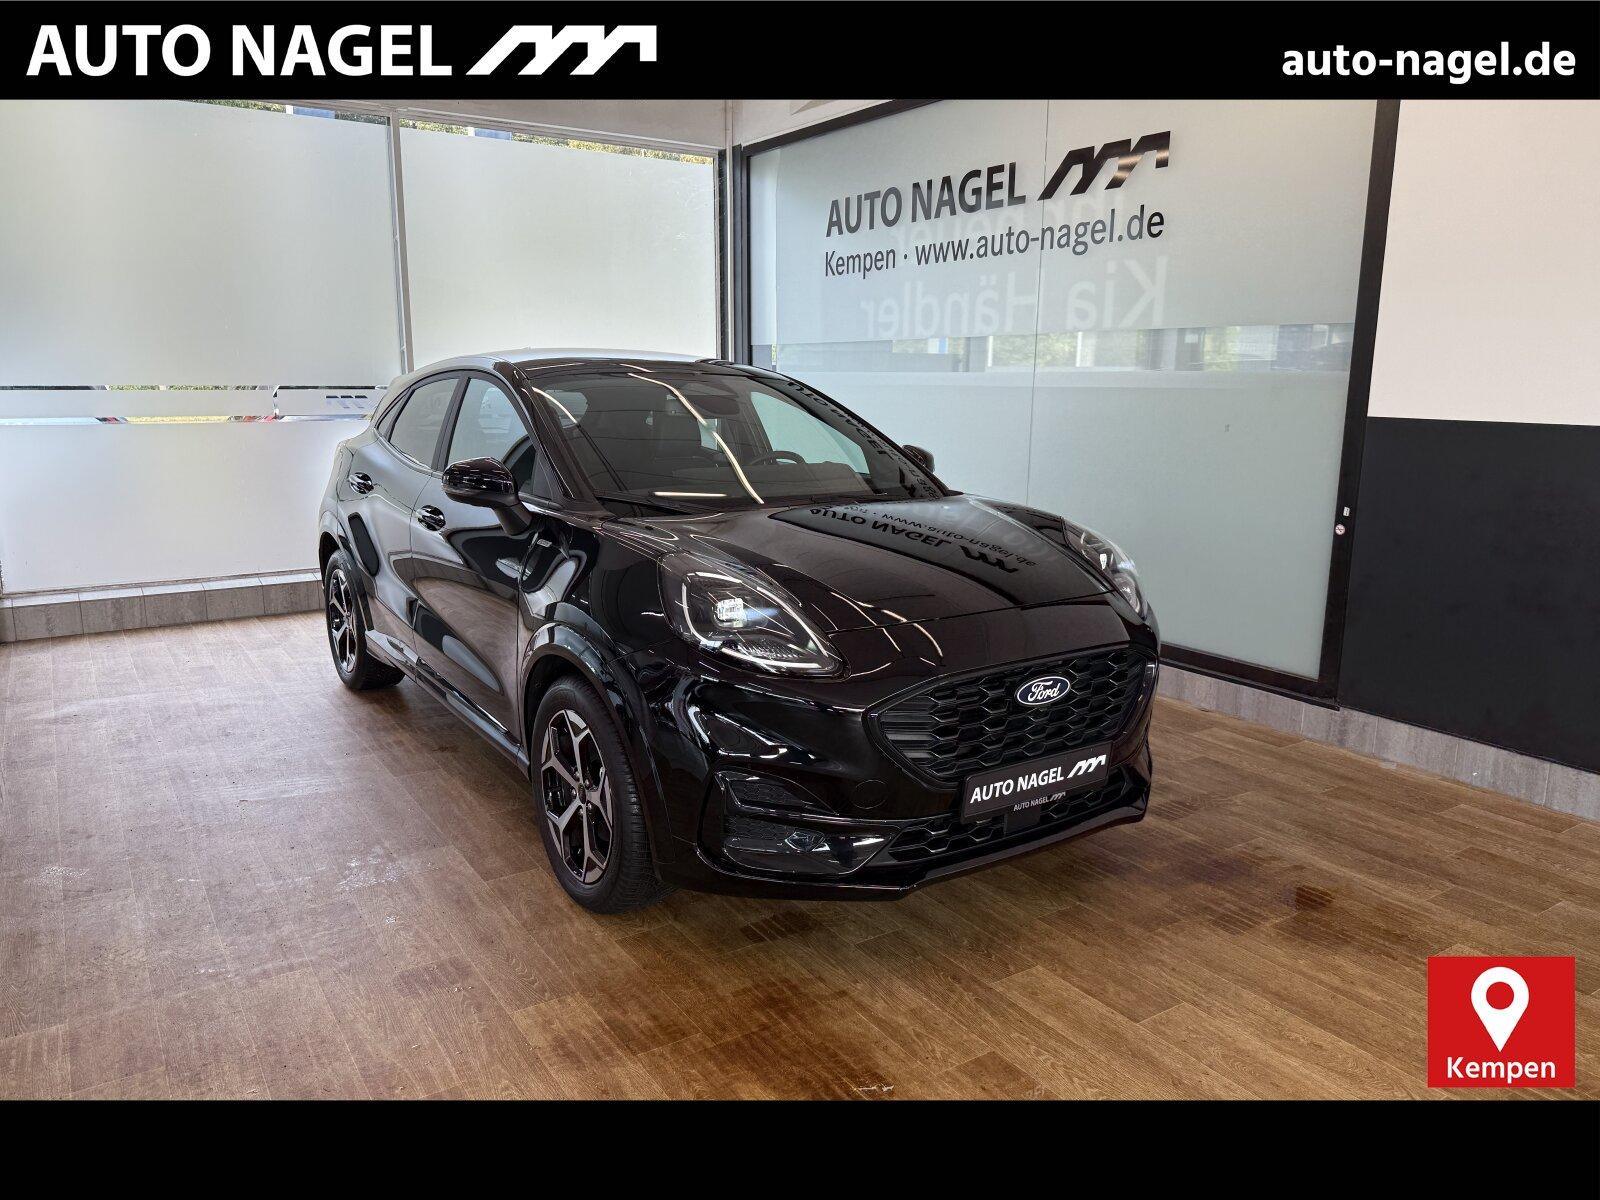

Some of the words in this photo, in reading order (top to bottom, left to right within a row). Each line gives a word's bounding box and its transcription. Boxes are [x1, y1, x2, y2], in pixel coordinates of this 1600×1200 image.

[825, 186, 902, 237] AUTO
[911, 161, 1027, 222] NAGEL
[825, 248, 896, 279] Kempen
[914, 204, 1164, 266] www.auto-nagel.de
[1028, 681, 1060, 701] Ford
[970, 779, 1014, 804] AUTO
[1016, 766, 1064, 792] NAGEL
[1013, 801, 1030, 812] AUTO
[1030, 796, 1050, 807] NAGEL
